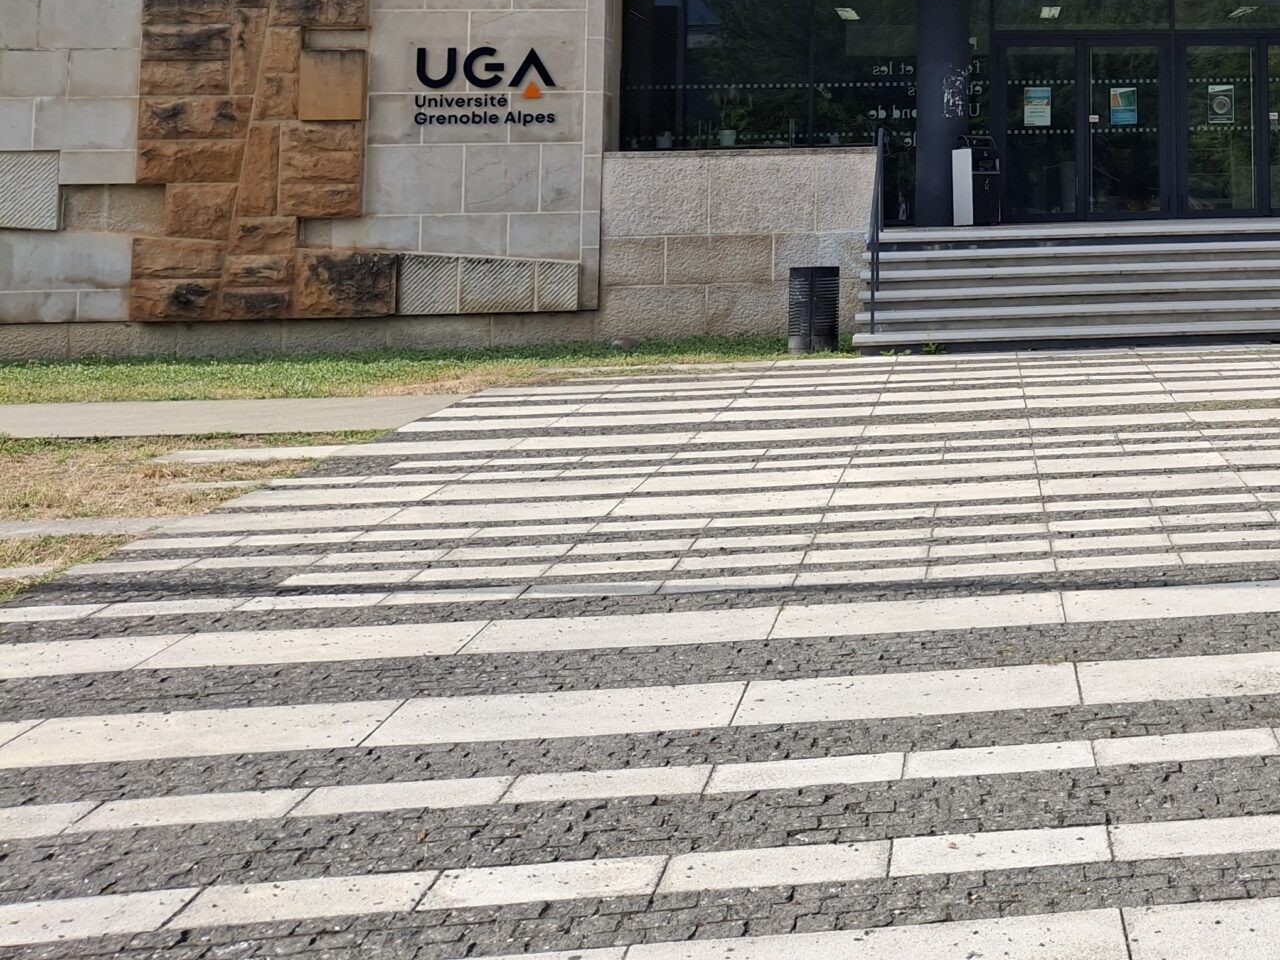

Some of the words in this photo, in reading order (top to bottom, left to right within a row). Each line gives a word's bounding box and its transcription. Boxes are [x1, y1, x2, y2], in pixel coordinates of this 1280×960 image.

[416, 46, 556, 89] UGA
[414, 93, 508, 109] Université
[414, 111, 500, 125] Grenoble
[504, 110, 556, 127] Alpes
